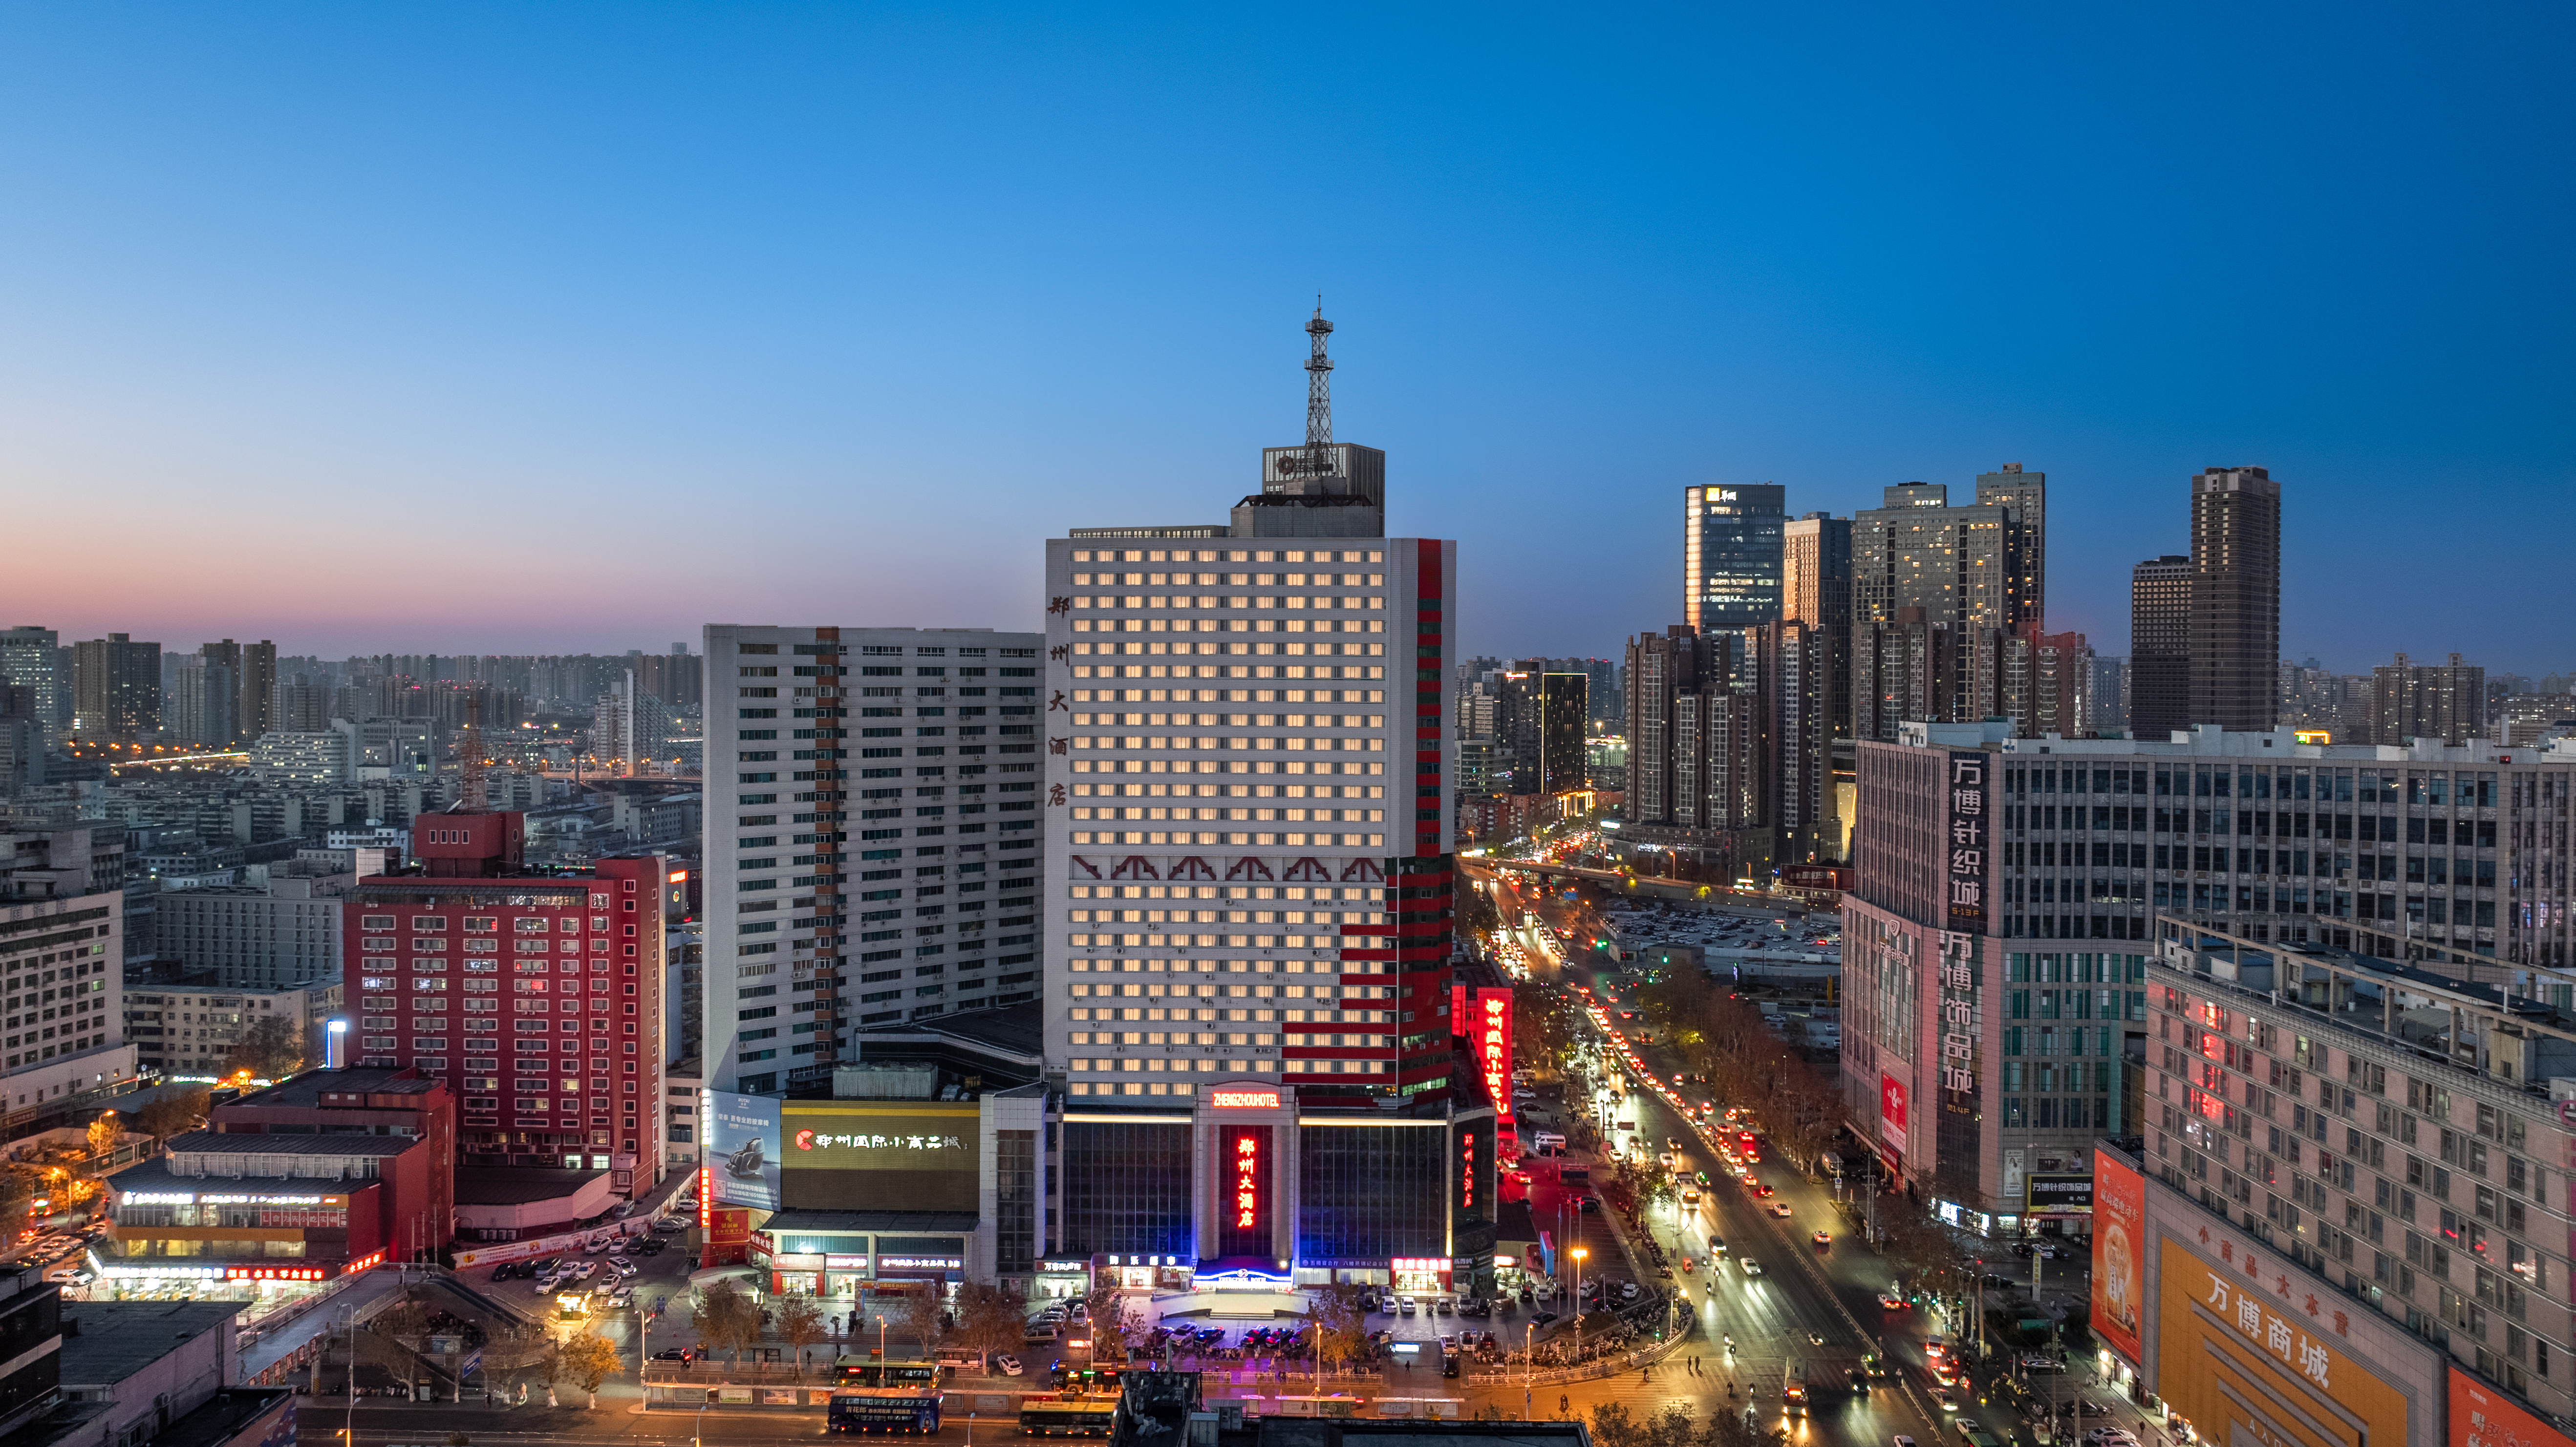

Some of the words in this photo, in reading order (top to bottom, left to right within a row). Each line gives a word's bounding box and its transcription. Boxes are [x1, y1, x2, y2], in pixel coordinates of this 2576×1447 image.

[1047, 596, 1070, 807] 郑州大酒店
[1952, 759, 1981, 907] 万博针织城
[1945, 931, 1973, 1094] 万博饰品城
[730, 1115, 769, 1127] 更专业的按摩椅
[1214, 1093, 1280, 1107] ZHENGZHOUHOTEL
[816, 1134, 961, 1150] 郑州国际小商品城
[1238, 1138, 1254, 1228] 郑州大酒店
[1463, 1133, 1474, 1208] 郑州大酒店
[2032, 1183, 2091, 1192] 万博针织饰品城
[254, 1269, 274, 1279] 水果
[2199, 1226, 2348, 1337] 小商品大本营
[2208, 1272, 2330, 1389] 万博商城
